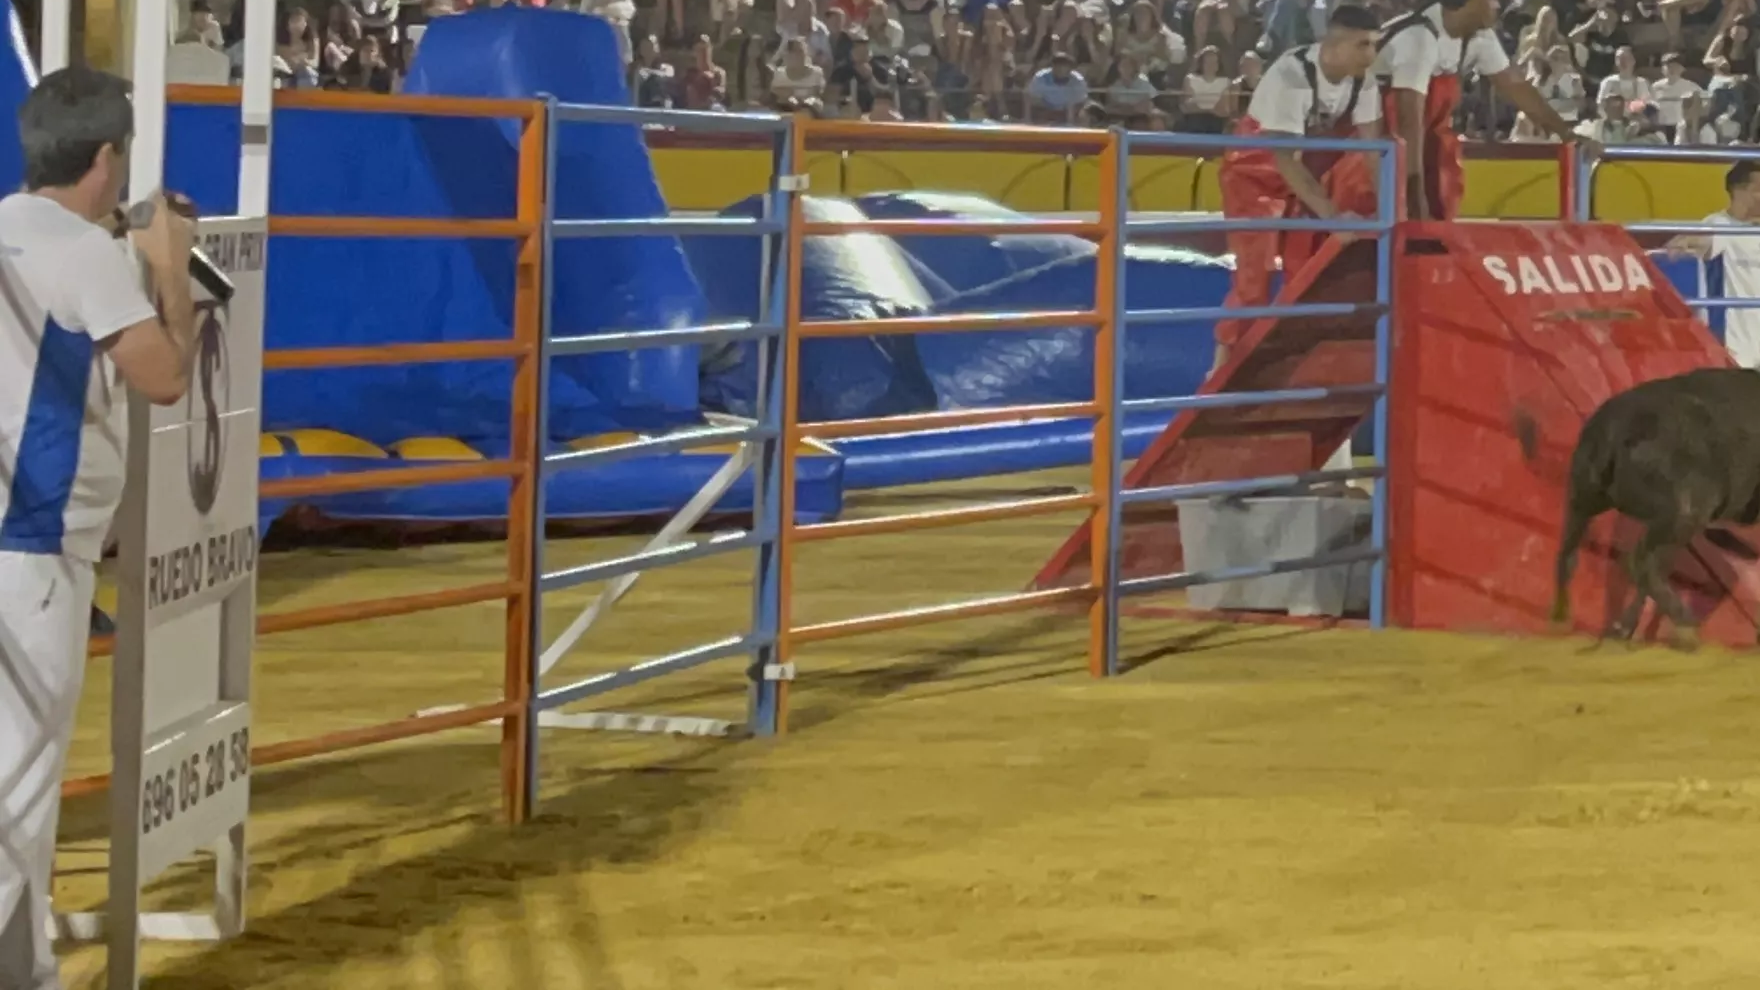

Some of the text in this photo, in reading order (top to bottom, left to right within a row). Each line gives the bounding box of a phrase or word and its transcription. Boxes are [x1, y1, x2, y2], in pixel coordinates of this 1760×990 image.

[1482, 253, 1655, 295] SALIDA
[148, 526, 255, 610] RUEDO BRAVO
[142, 767, 176, 834] 696
[179, 754, 200, 813] 05
[205, 739, 226, 798] 28
